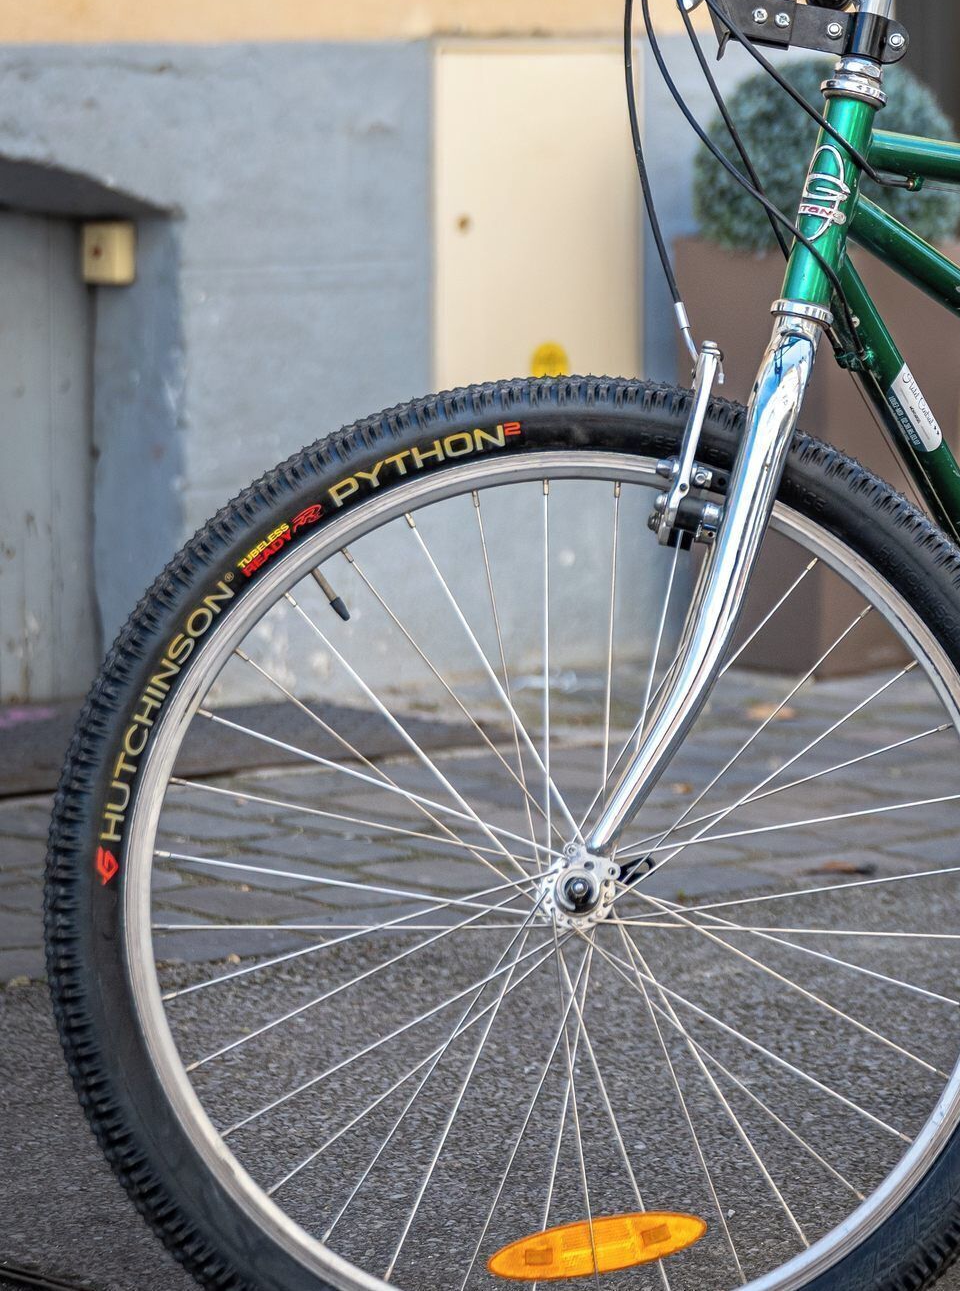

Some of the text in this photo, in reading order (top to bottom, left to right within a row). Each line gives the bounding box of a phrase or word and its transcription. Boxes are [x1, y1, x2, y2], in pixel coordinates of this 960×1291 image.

[237, 523, 289, 568] TUBELESS
[241, 528, 292, 577] READY
[101, 581, 235, 843] HUTCHINSON
